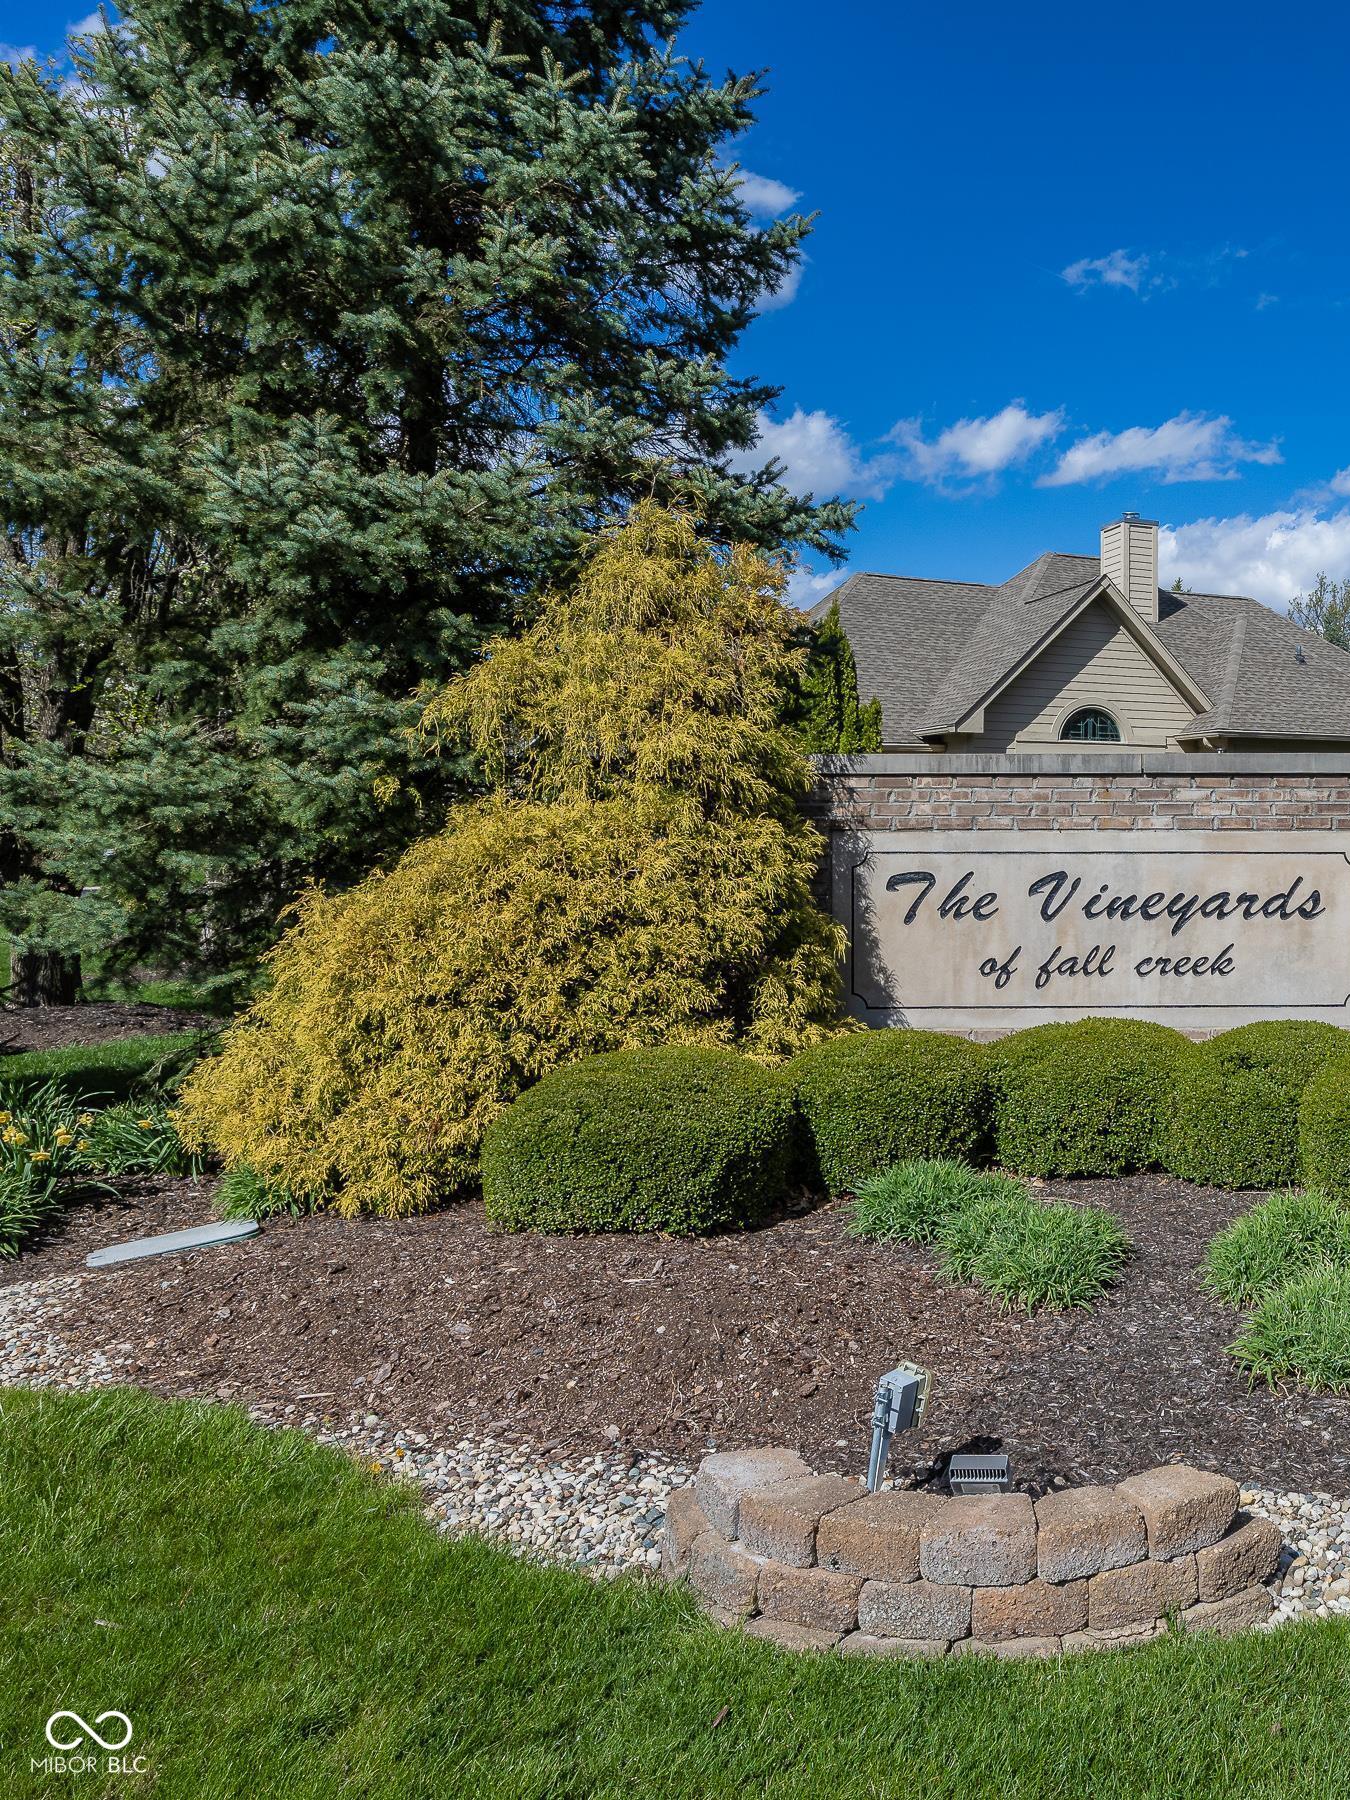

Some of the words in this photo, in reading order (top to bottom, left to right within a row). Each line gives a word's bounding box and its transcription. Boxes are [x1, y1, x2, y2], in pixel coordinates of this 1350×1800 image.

[885, 871, 999, 926] The
[1028, 871, 1326, 937] Vineyards
[978, 945, 1022, 990] of
[1034, 944, 1115, 990] fall
[1133, 943, 1236, 977] creek
